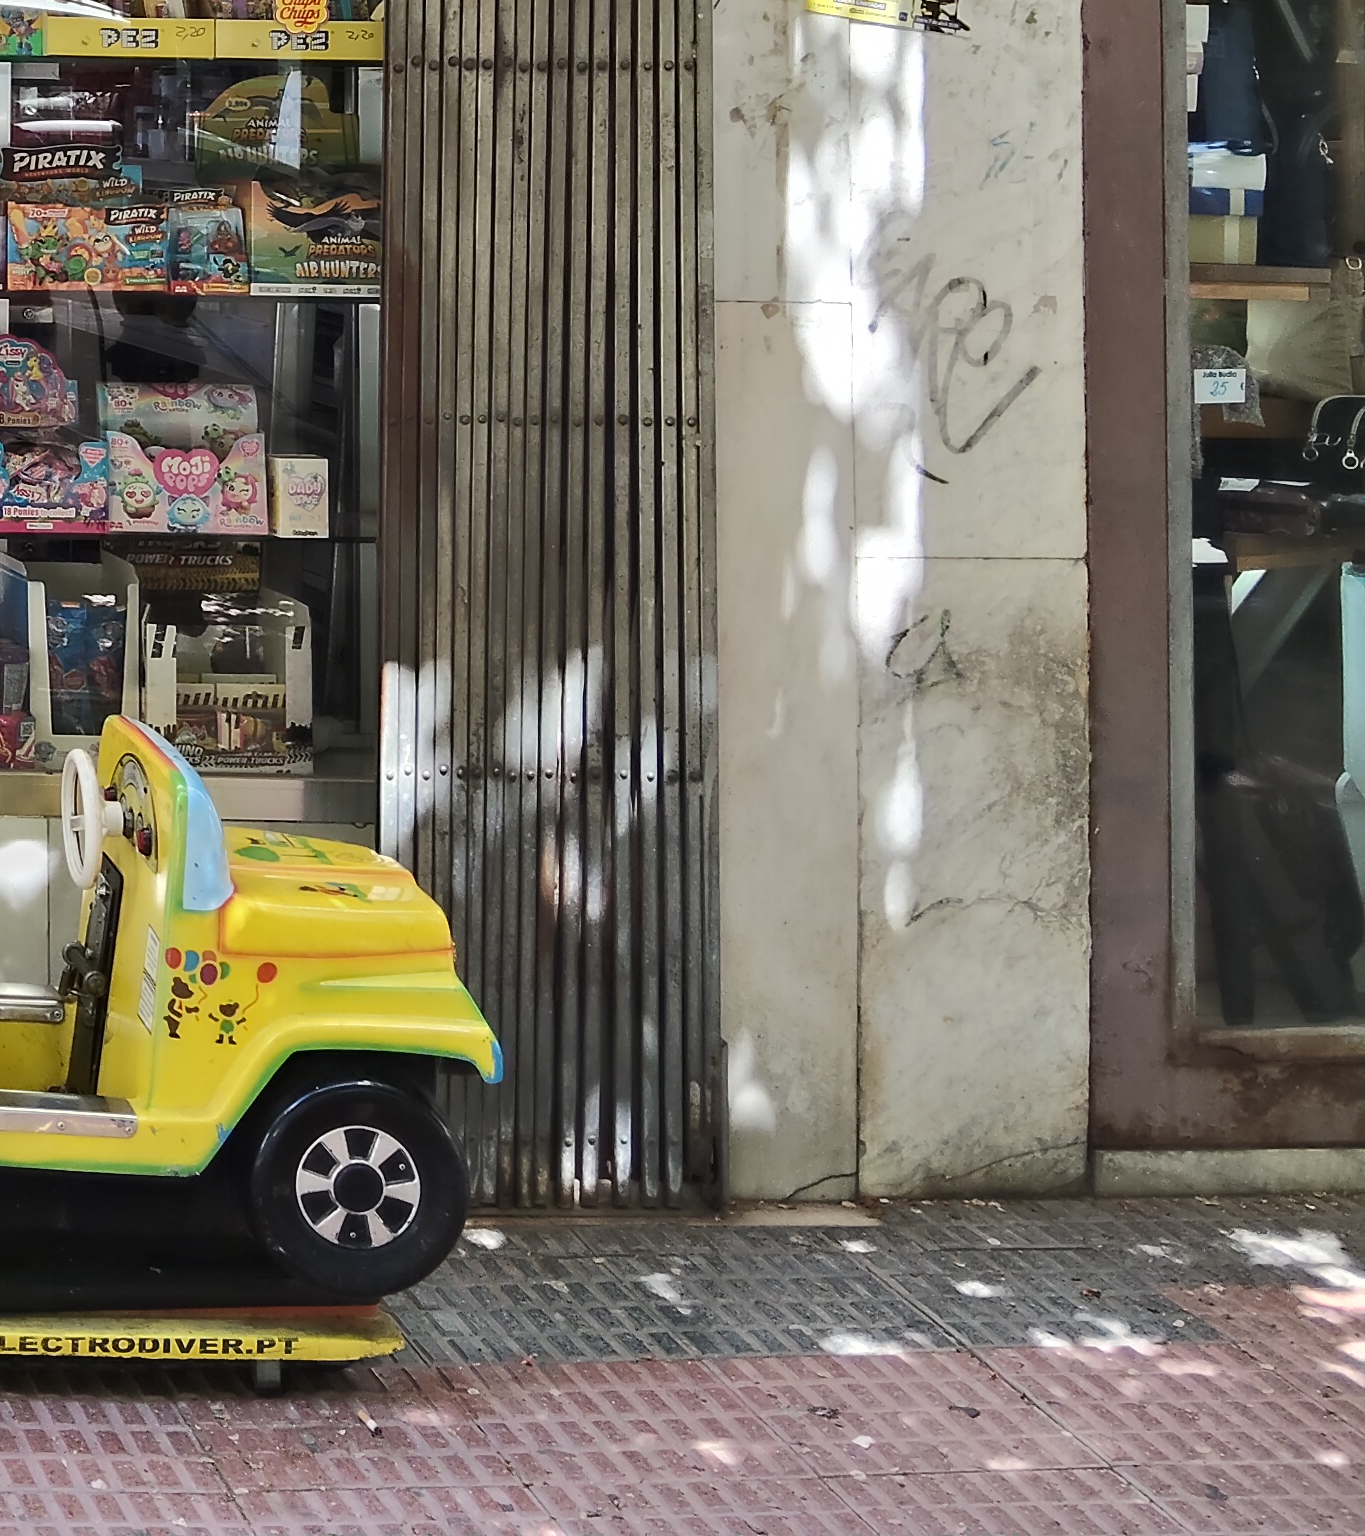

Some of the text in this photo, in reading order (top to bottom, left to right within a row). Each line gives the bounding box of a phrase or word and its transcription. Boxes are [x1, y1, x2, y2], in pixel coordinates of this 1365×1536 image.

[280, 7, 321, 27] Chups
[99, 28, 159, 49] PEZ
[175, 26, 205, 41] 2,20
[345, 30, 374, 41] 2,20
[269, 31, 329, 51] PEZ
[13, 150, 107, 173] PIRATIX
[102, 177, 128, 188] WILD
[174, 191, 216, 203] PIRATIX
[109, 208, 158, 221] PIRATIX
[135, 225, 157, 234] WILD
[321, 234, 363, 244] ANIMAL
[308, 245, 377, 258] PREDATORS
[296, 263, 319, 278] AIR
[1210, 381, 1230, 396] 25
[3, 507, 12, 516] 18
[13, 507, 39, 516] Ponies
[180, 555, 233, 565] TRUCKS
